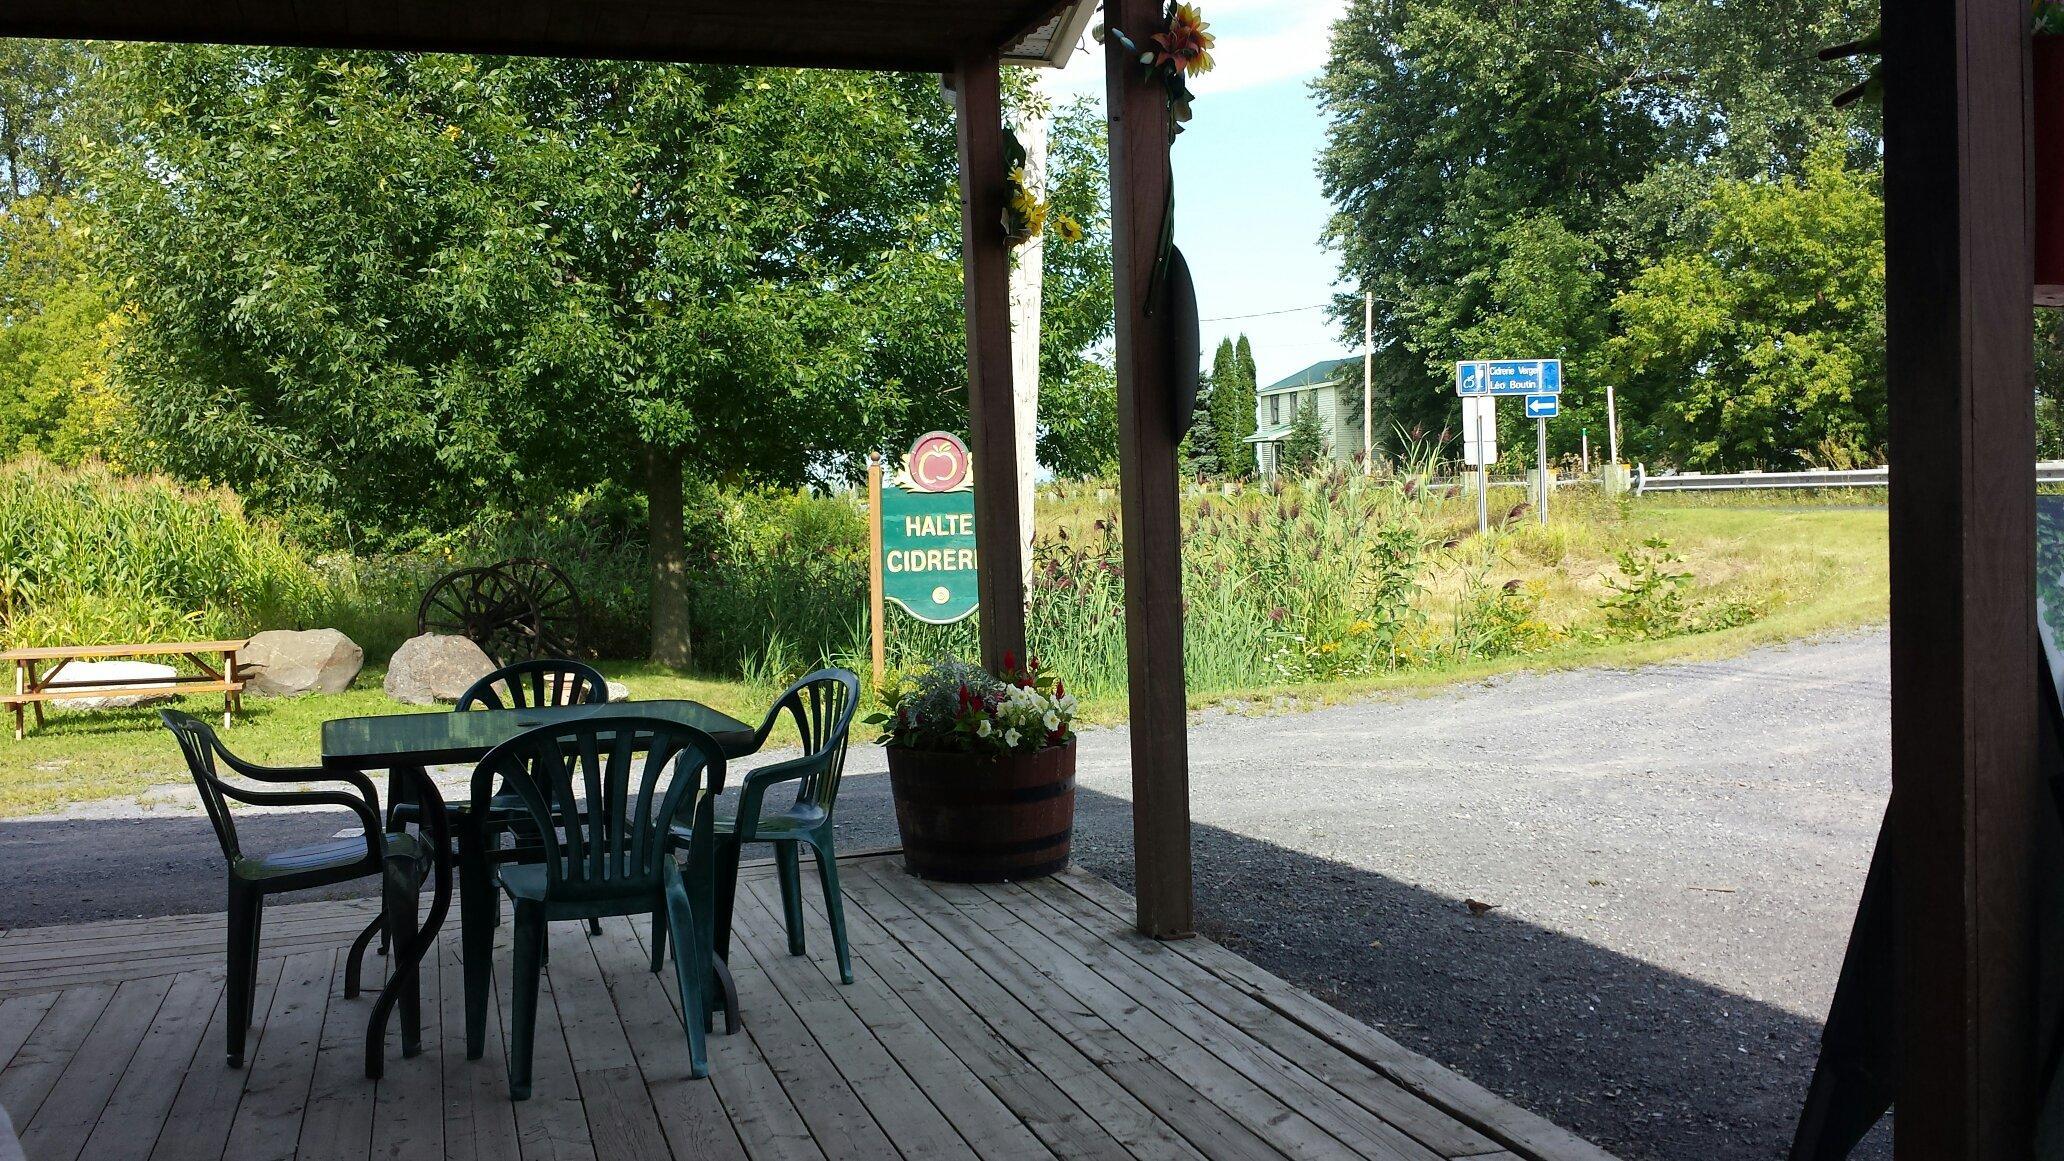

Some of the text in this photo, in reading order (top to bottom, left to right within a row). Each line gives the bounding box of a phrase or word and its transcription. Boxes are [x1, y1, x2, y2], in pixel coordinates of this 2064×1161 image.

[1490, 366, 1515, 376] Cidrerie
[1490, 380, 1536, 390] Léo Boutin
[905, 513, 974, 537] HALTE
